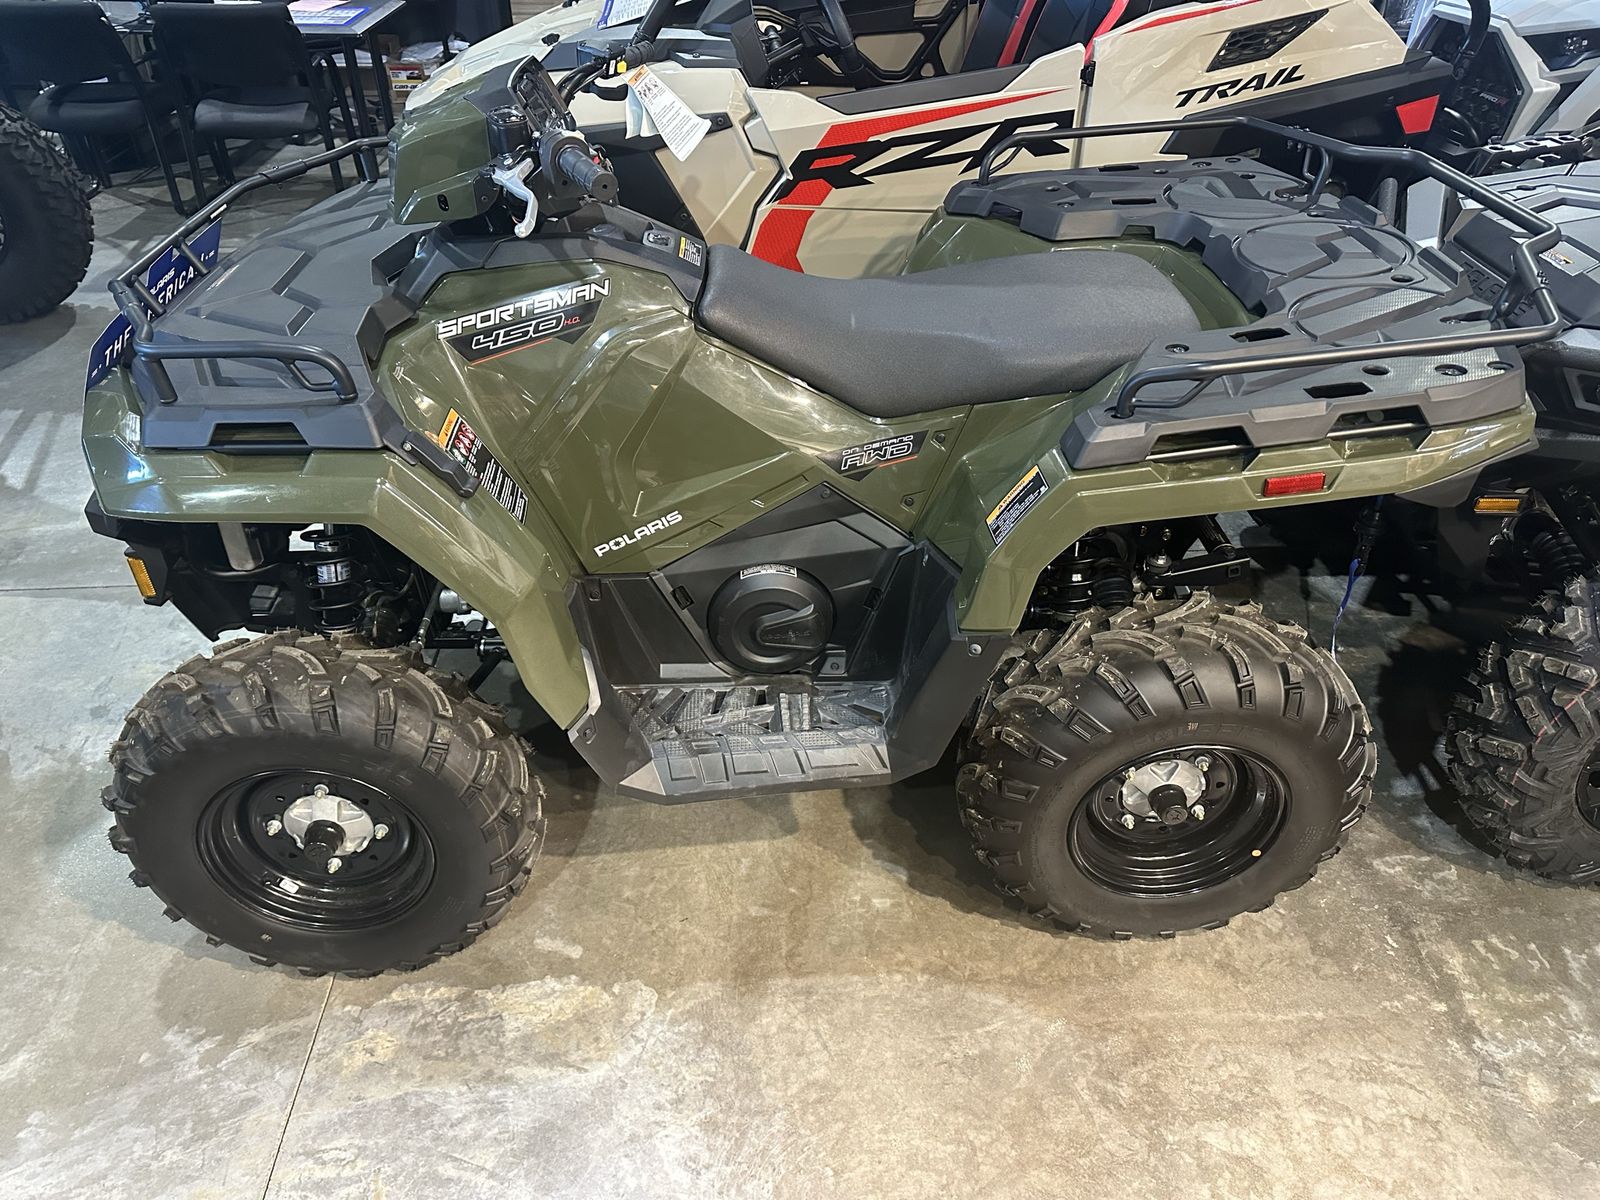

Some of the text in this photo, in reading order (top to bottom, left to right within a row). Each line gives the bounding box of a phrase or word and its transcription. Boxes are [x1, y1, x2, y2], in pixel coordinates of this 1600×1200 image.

[1175, 64, 1305, 109] TRAIL
[768, 109, 1075, 203] RZR
[437, 278, 611, 341] SPORTSMAN
[472, 312, 565, 350] 450
[840, 441, 913, 471] AWD
[863, 434, 914, 451] DEMAND
[593, 510, 683, 558] POLARIS
